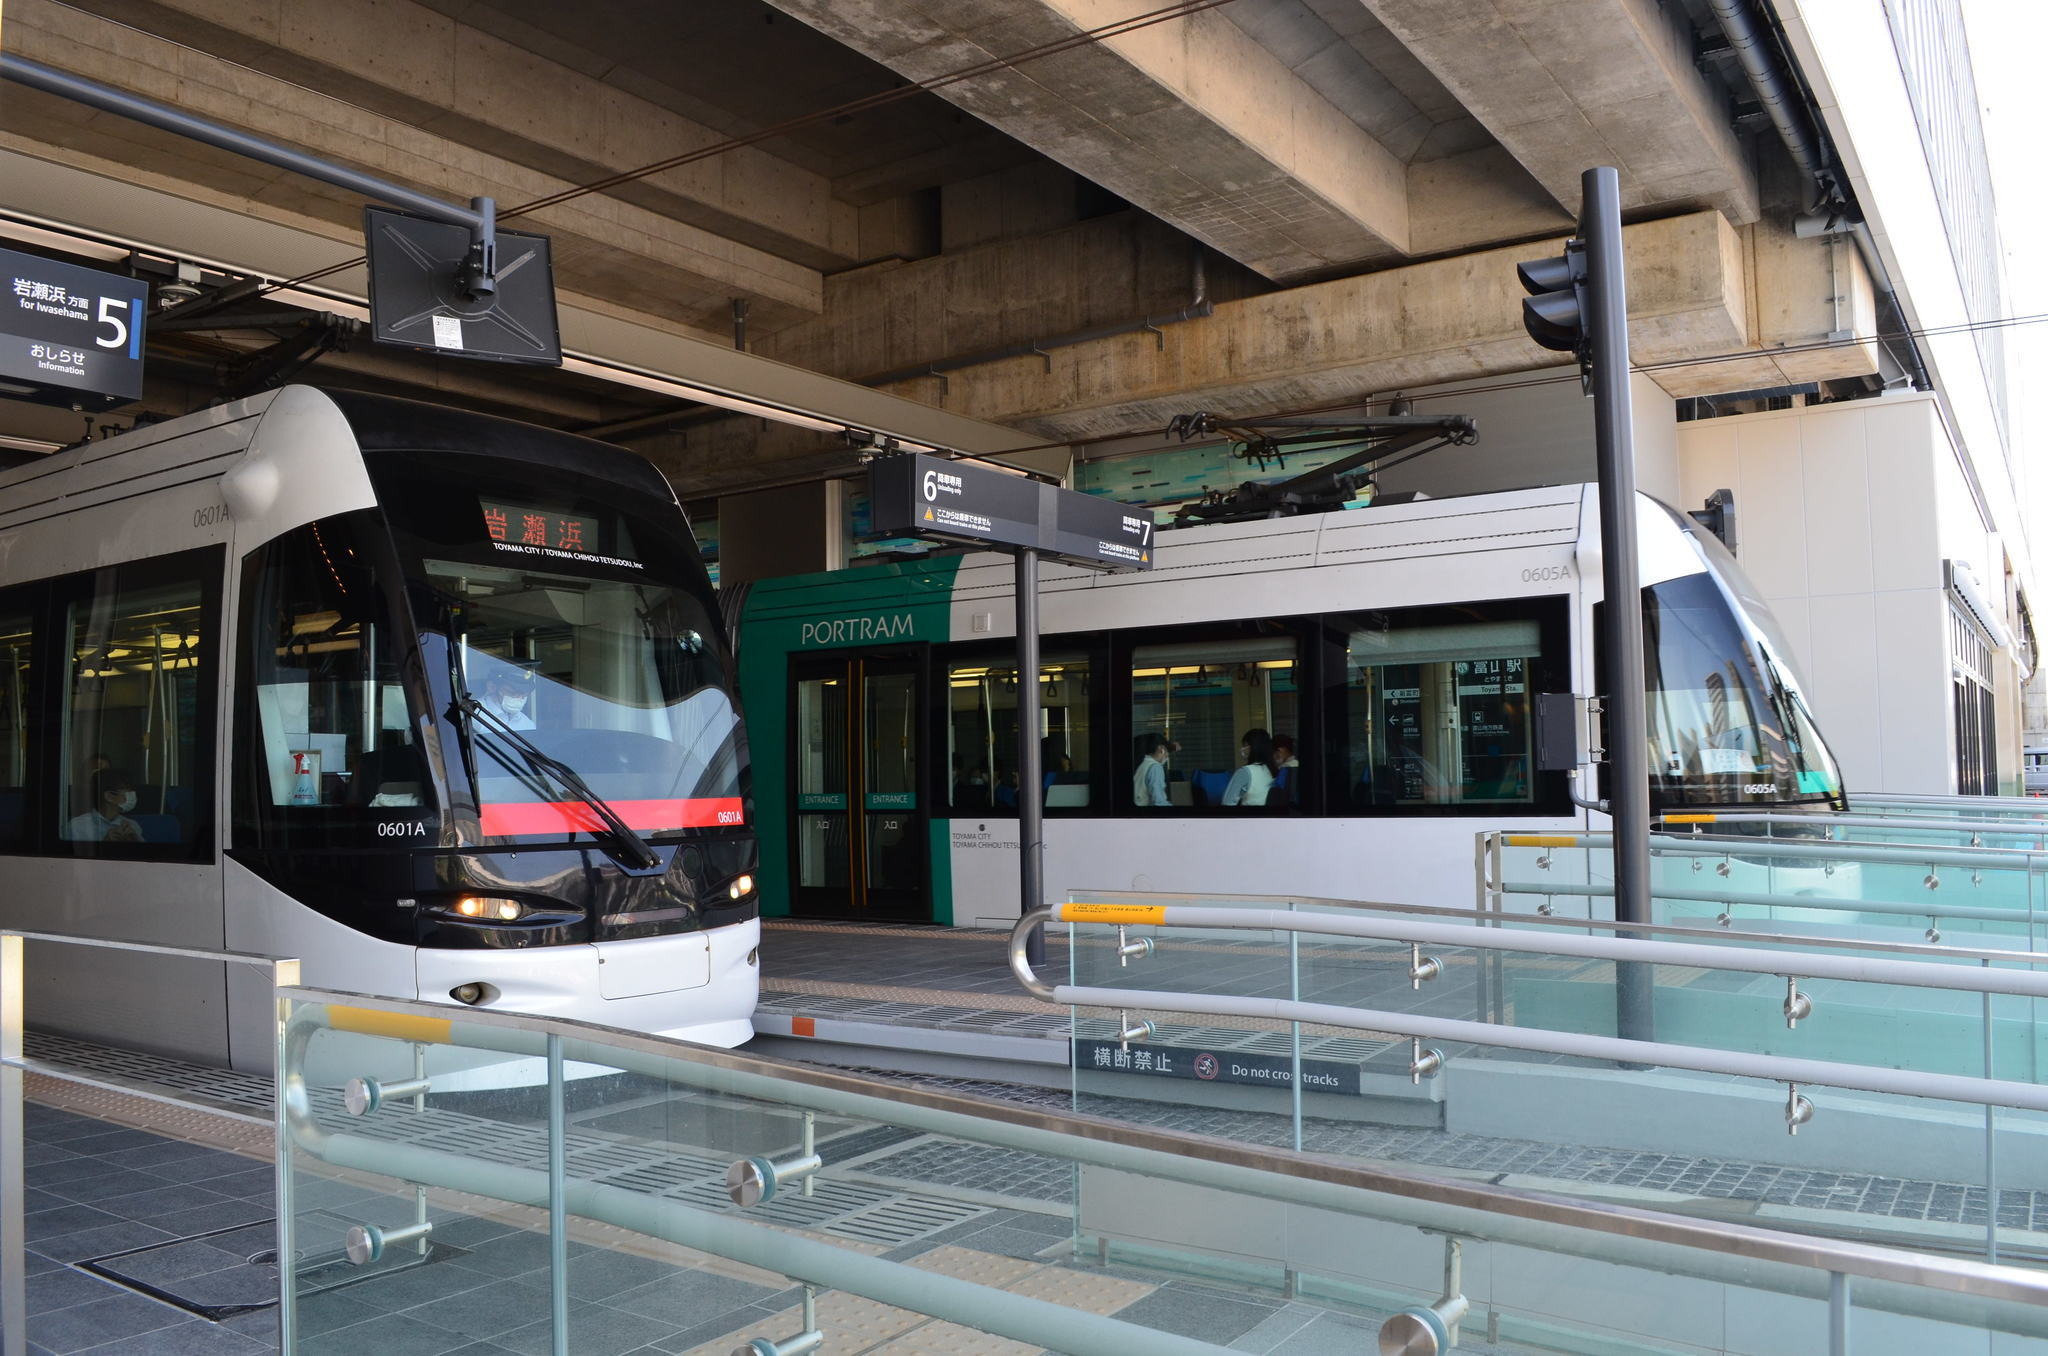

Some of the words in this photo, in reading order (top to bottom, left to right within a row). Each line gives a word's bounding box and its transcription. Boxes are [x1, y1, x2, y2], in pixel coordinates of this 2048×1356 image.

[13, 278, 66, 304] 岩瀬浜
[68, 295, 89, 309] 方面
[20, 298, 34, 310] for
[37, 301, 89, 321] Iwasehama
[96, 296, 128, 349] 5
[31, 344, 85, 366] おしらせ
[38, 360, 85, 376] Information
[923, 470, 937, 501] 6
[193, 503, 229, 528] 0601A
[484, 507, 584, 551] 岩瀬浜
[1141, 520, 1151, 546] 7
[493, 542, 524, 553] TOYAMA
[524, 546, 540, 555] CITY
[544, 548, 573, 559] TOYAMA
[573, 552, 600, 562] CHIHOU
[1521, 565, 1571, 582] 0605A
[802, 614, 914, 645] PORTRAM
[872, 794, 908, 804] ENTRANCE
[1744, 783, 1778, 794] 0605A
[805, 795, 840, 804] ENTRANCE
[718, 811, 742, 823] 0601A
[816, 820, 830, 830] 入口
[884, 820, 898, 830] 入口
[378, 822, 426, 836] 0601A
[952, 841, 977, 849] TOYAMA
[977, 841, 1002, 849] CHIHOU
[1094, 1046, 1172, 1073] 横断禁止
[1232, 1064, 1248, 1077] Do
[1250, 1067, 1270, 1079] not
[1272, 1070, 1293, 1081] cro
[1302, 1072, 1339, 1087] tracks
